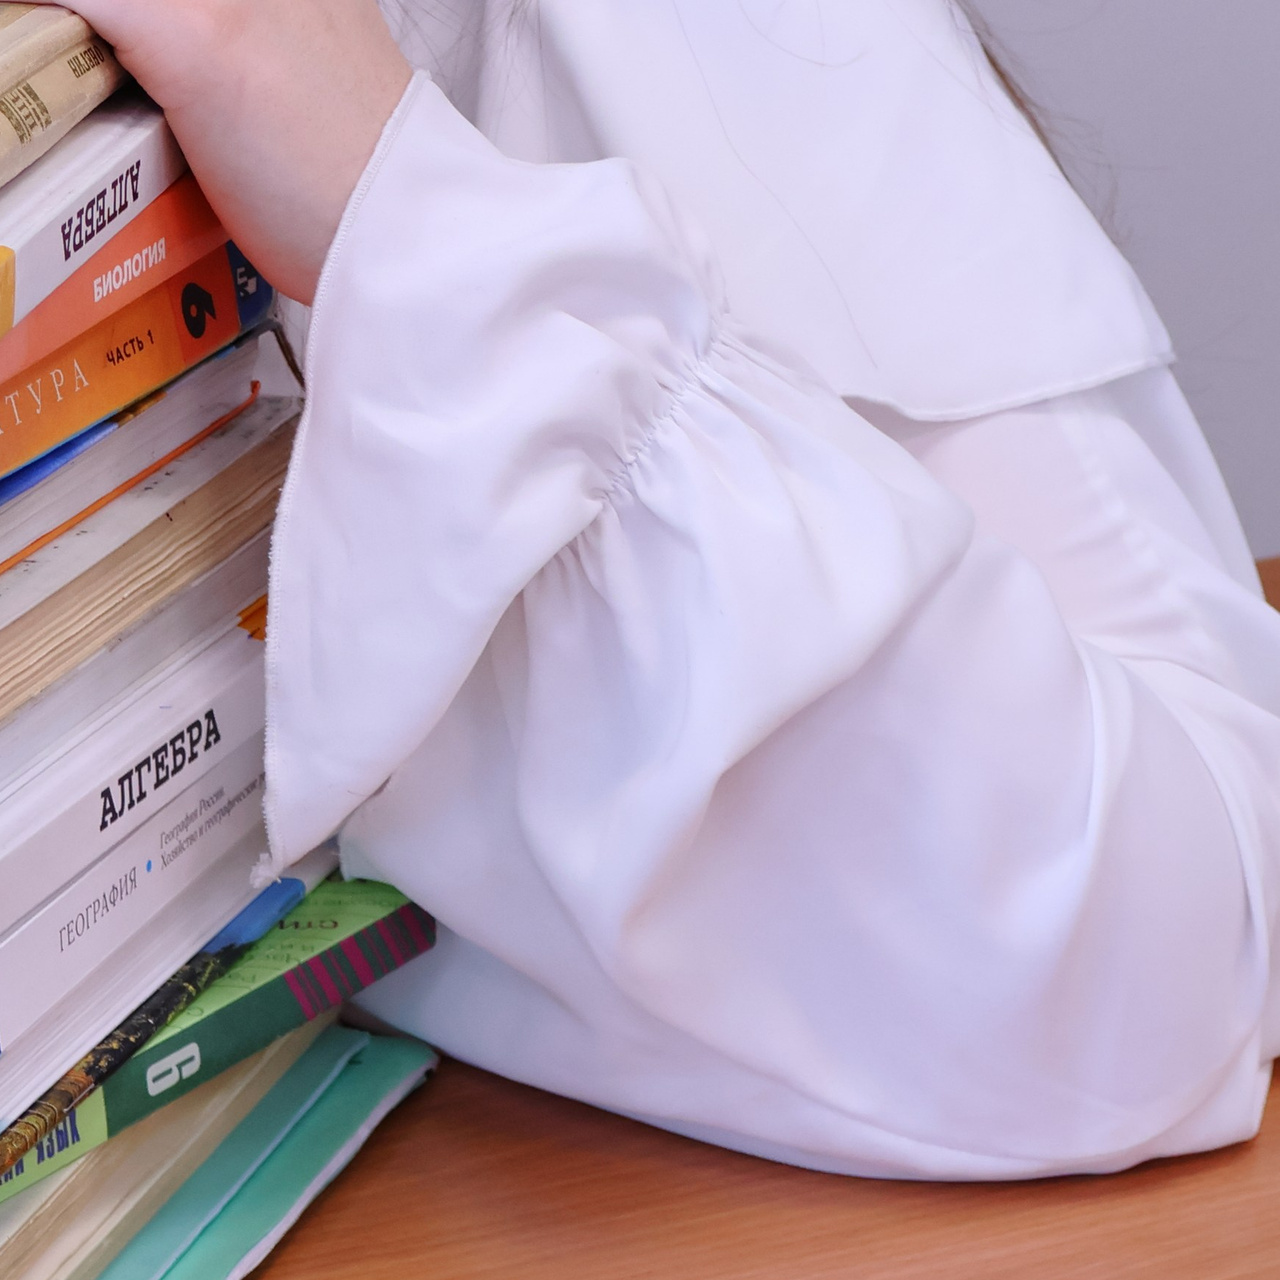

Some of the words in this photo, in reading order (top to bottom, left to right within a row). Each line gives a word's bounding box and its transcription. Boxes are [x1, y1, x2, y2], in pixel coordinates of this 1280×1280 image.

[66, 44, 105, 79] ОНЕГИН
[61, 158, 142, 263] АЛГЕБРА
[92, 237, 167, 303] БИОЛОГИЯ
[106, 335, 145, 368] ЧАСТЬ
[146, 329, 155, 345] 1
[98, 707, 222, 833] АЛГЕБРА
[57, 865, 140, 954] ГЕОГРАФИЯ
[35, 1107, 81, 1166] ЯЗЫК
